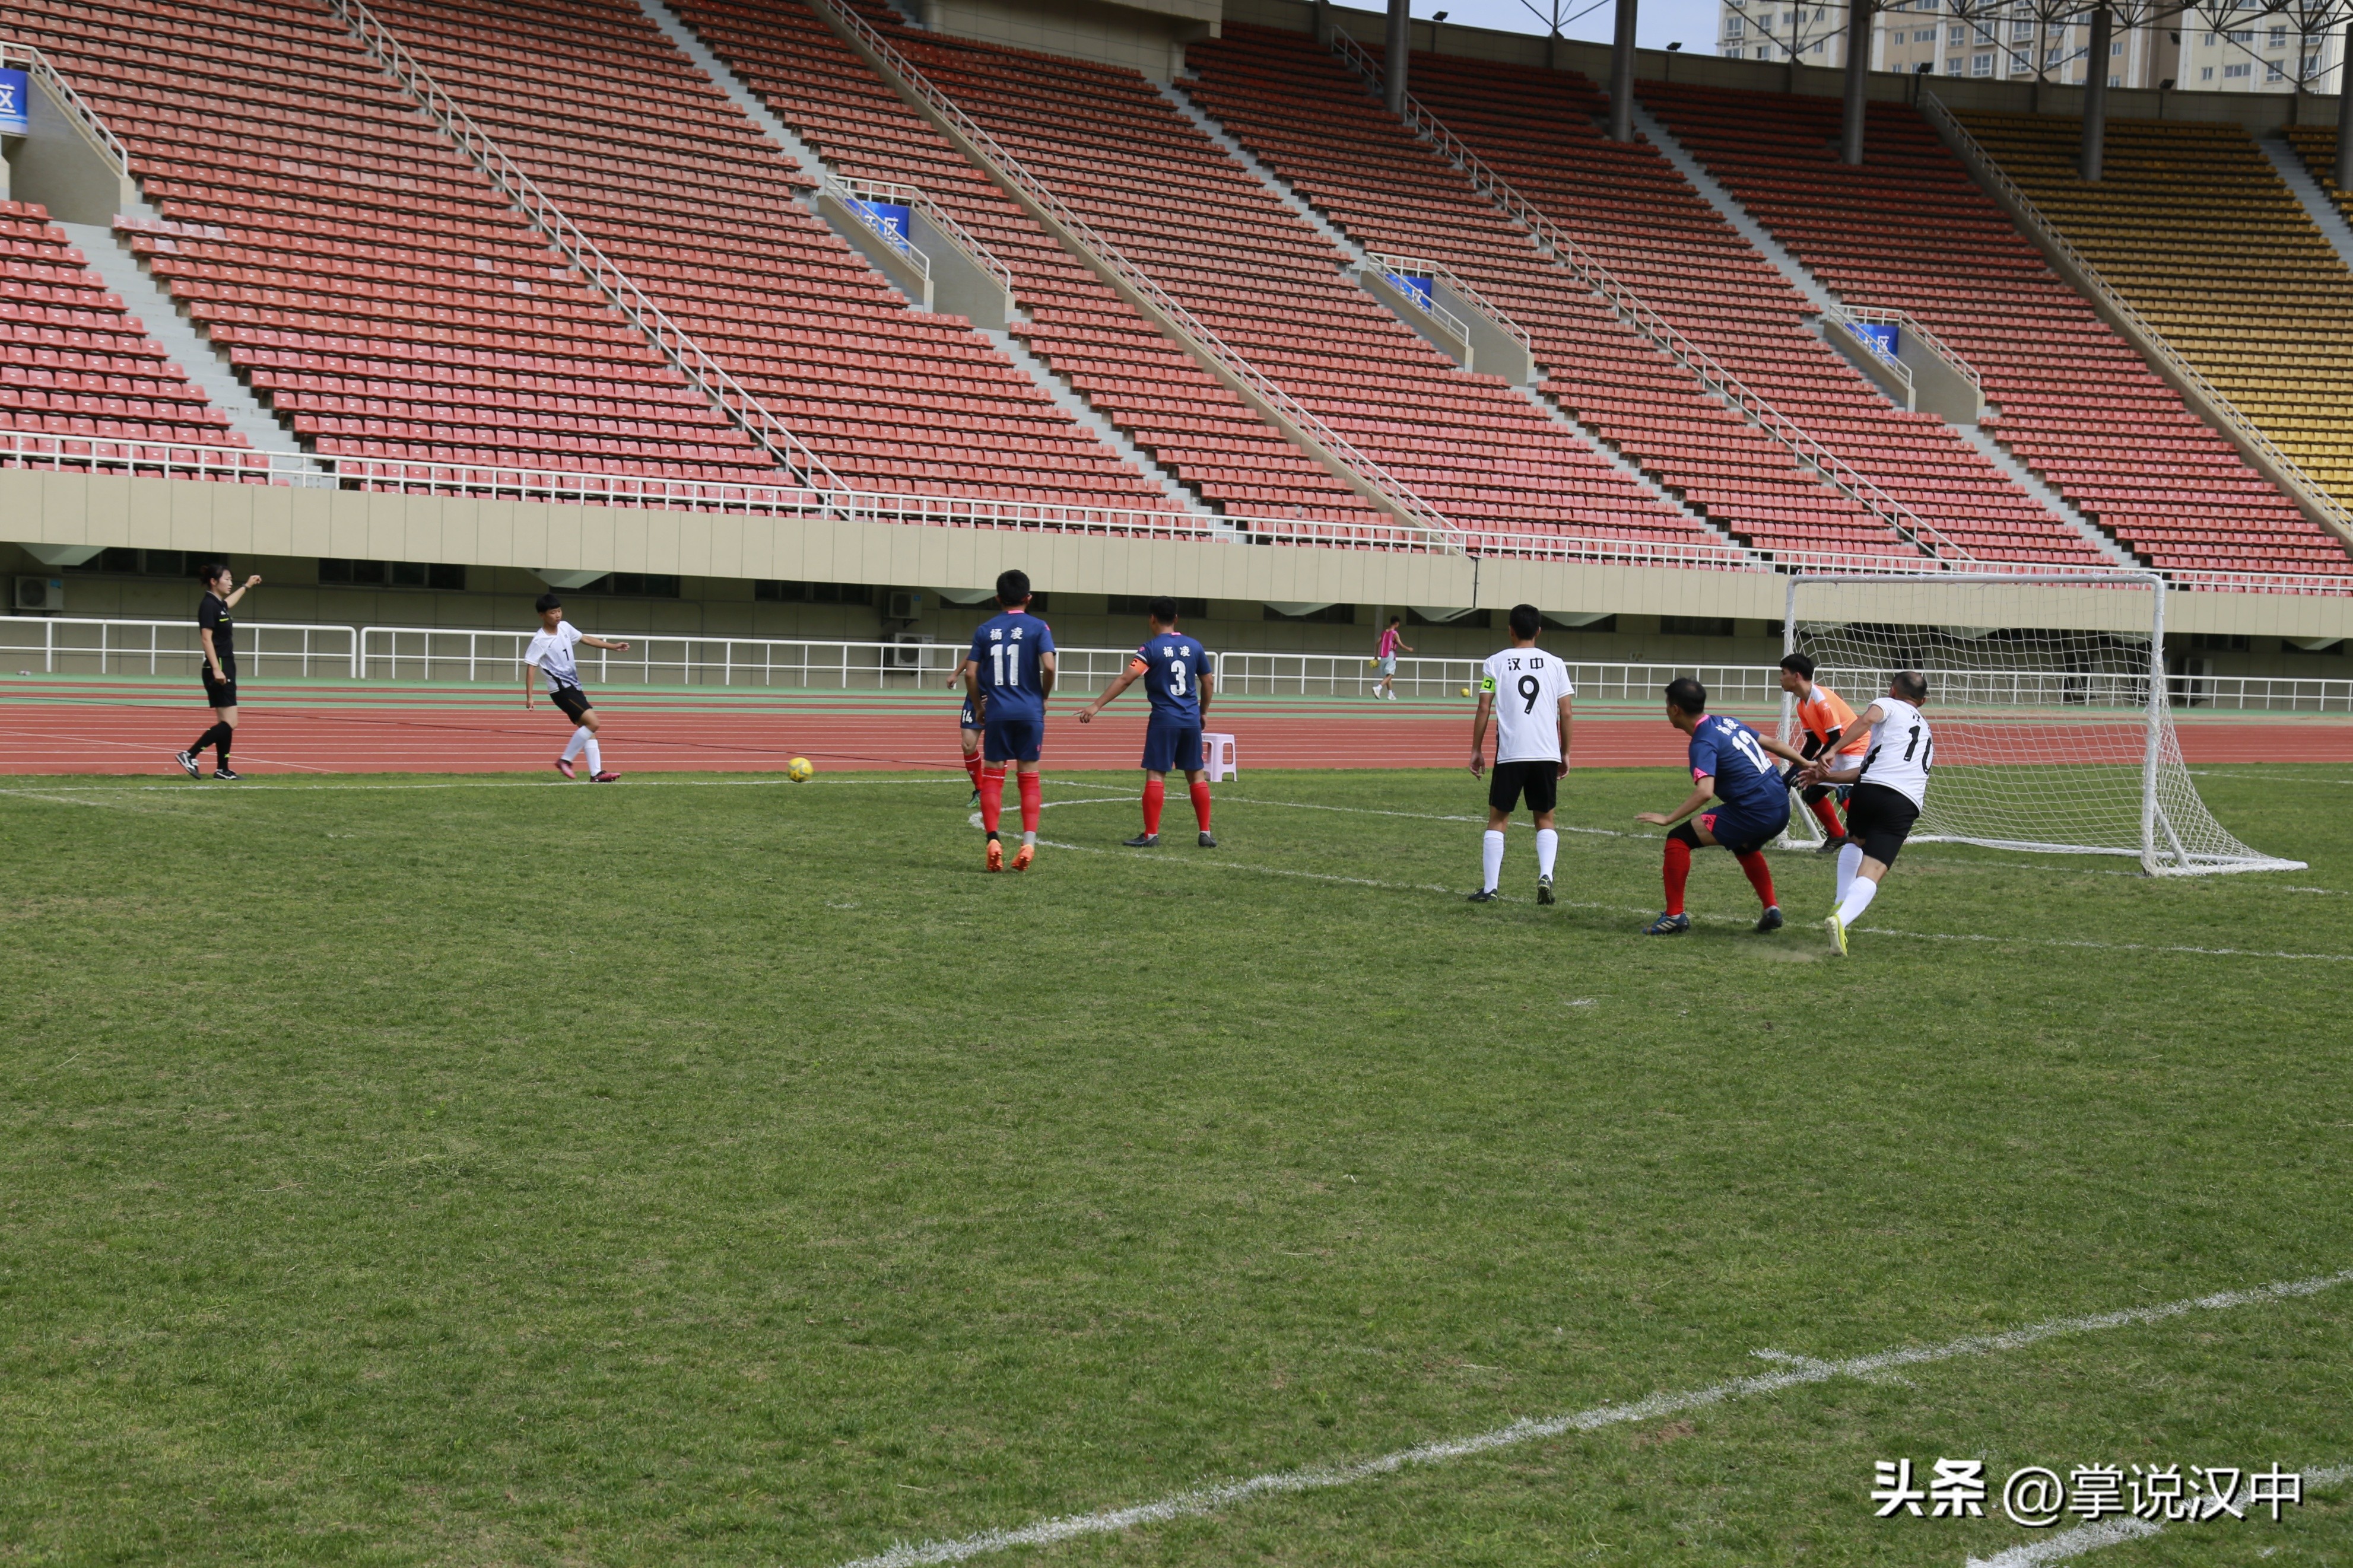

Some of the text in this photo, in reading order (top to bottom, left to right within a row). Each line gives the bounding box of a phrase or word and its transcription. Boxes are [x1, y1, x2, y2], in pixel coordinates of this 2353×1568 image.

[990, 626, 1023, 641] 杨凌
[1163, 645, 1190, 658] 杨凌
[990, 644, 1020, 686] 11
[1507, 657, 1544, 672] 汉中
[1170, 660, 1186, 696] 3
[1517, 675, 1540, 715] 9
[962, 709, 973, 723] 14
[1732, 730, 1773, 775] 12
